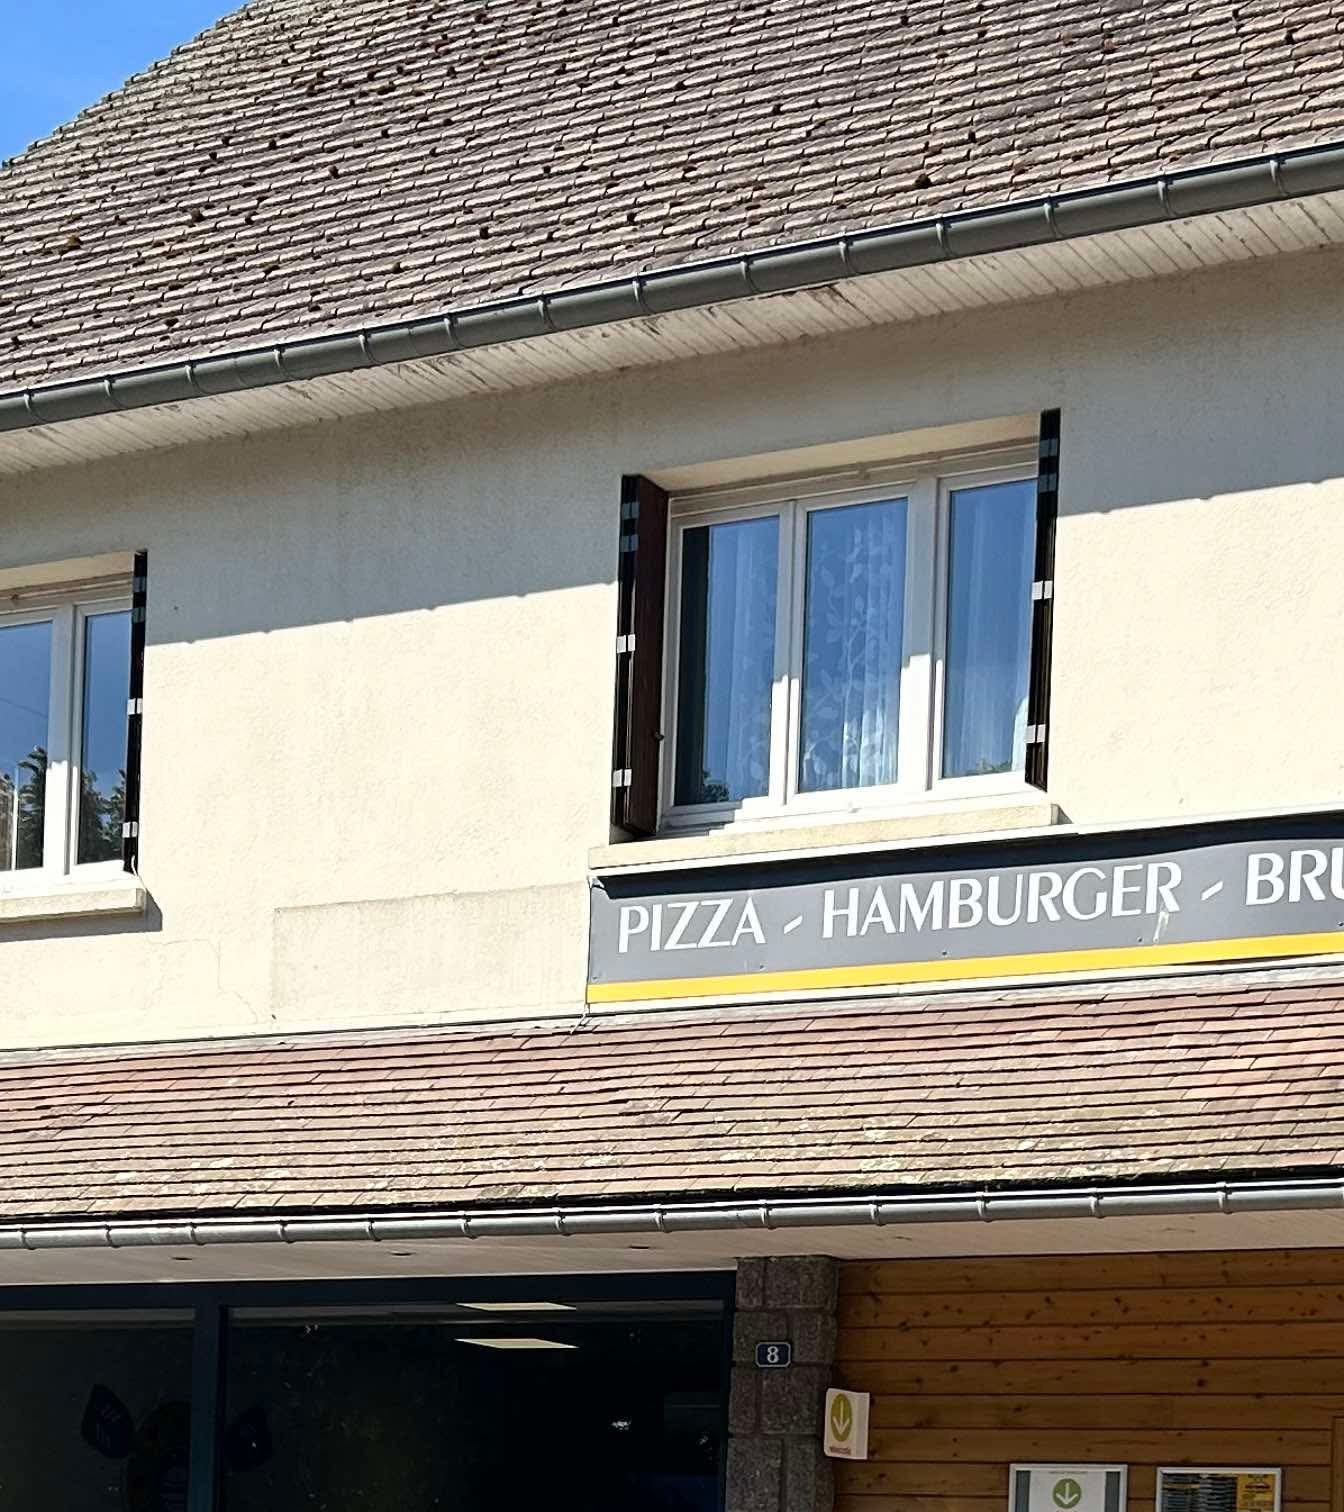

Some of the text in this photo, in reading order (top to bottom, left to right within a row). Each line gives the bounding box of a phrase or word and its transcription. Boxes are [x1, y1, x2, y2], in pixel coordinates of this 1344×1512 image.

[618, 896, 766, 954] PIZZA
[821, 861, 1183, 939] HAMBURGER
[766, 1345, 779, 1364] 8
